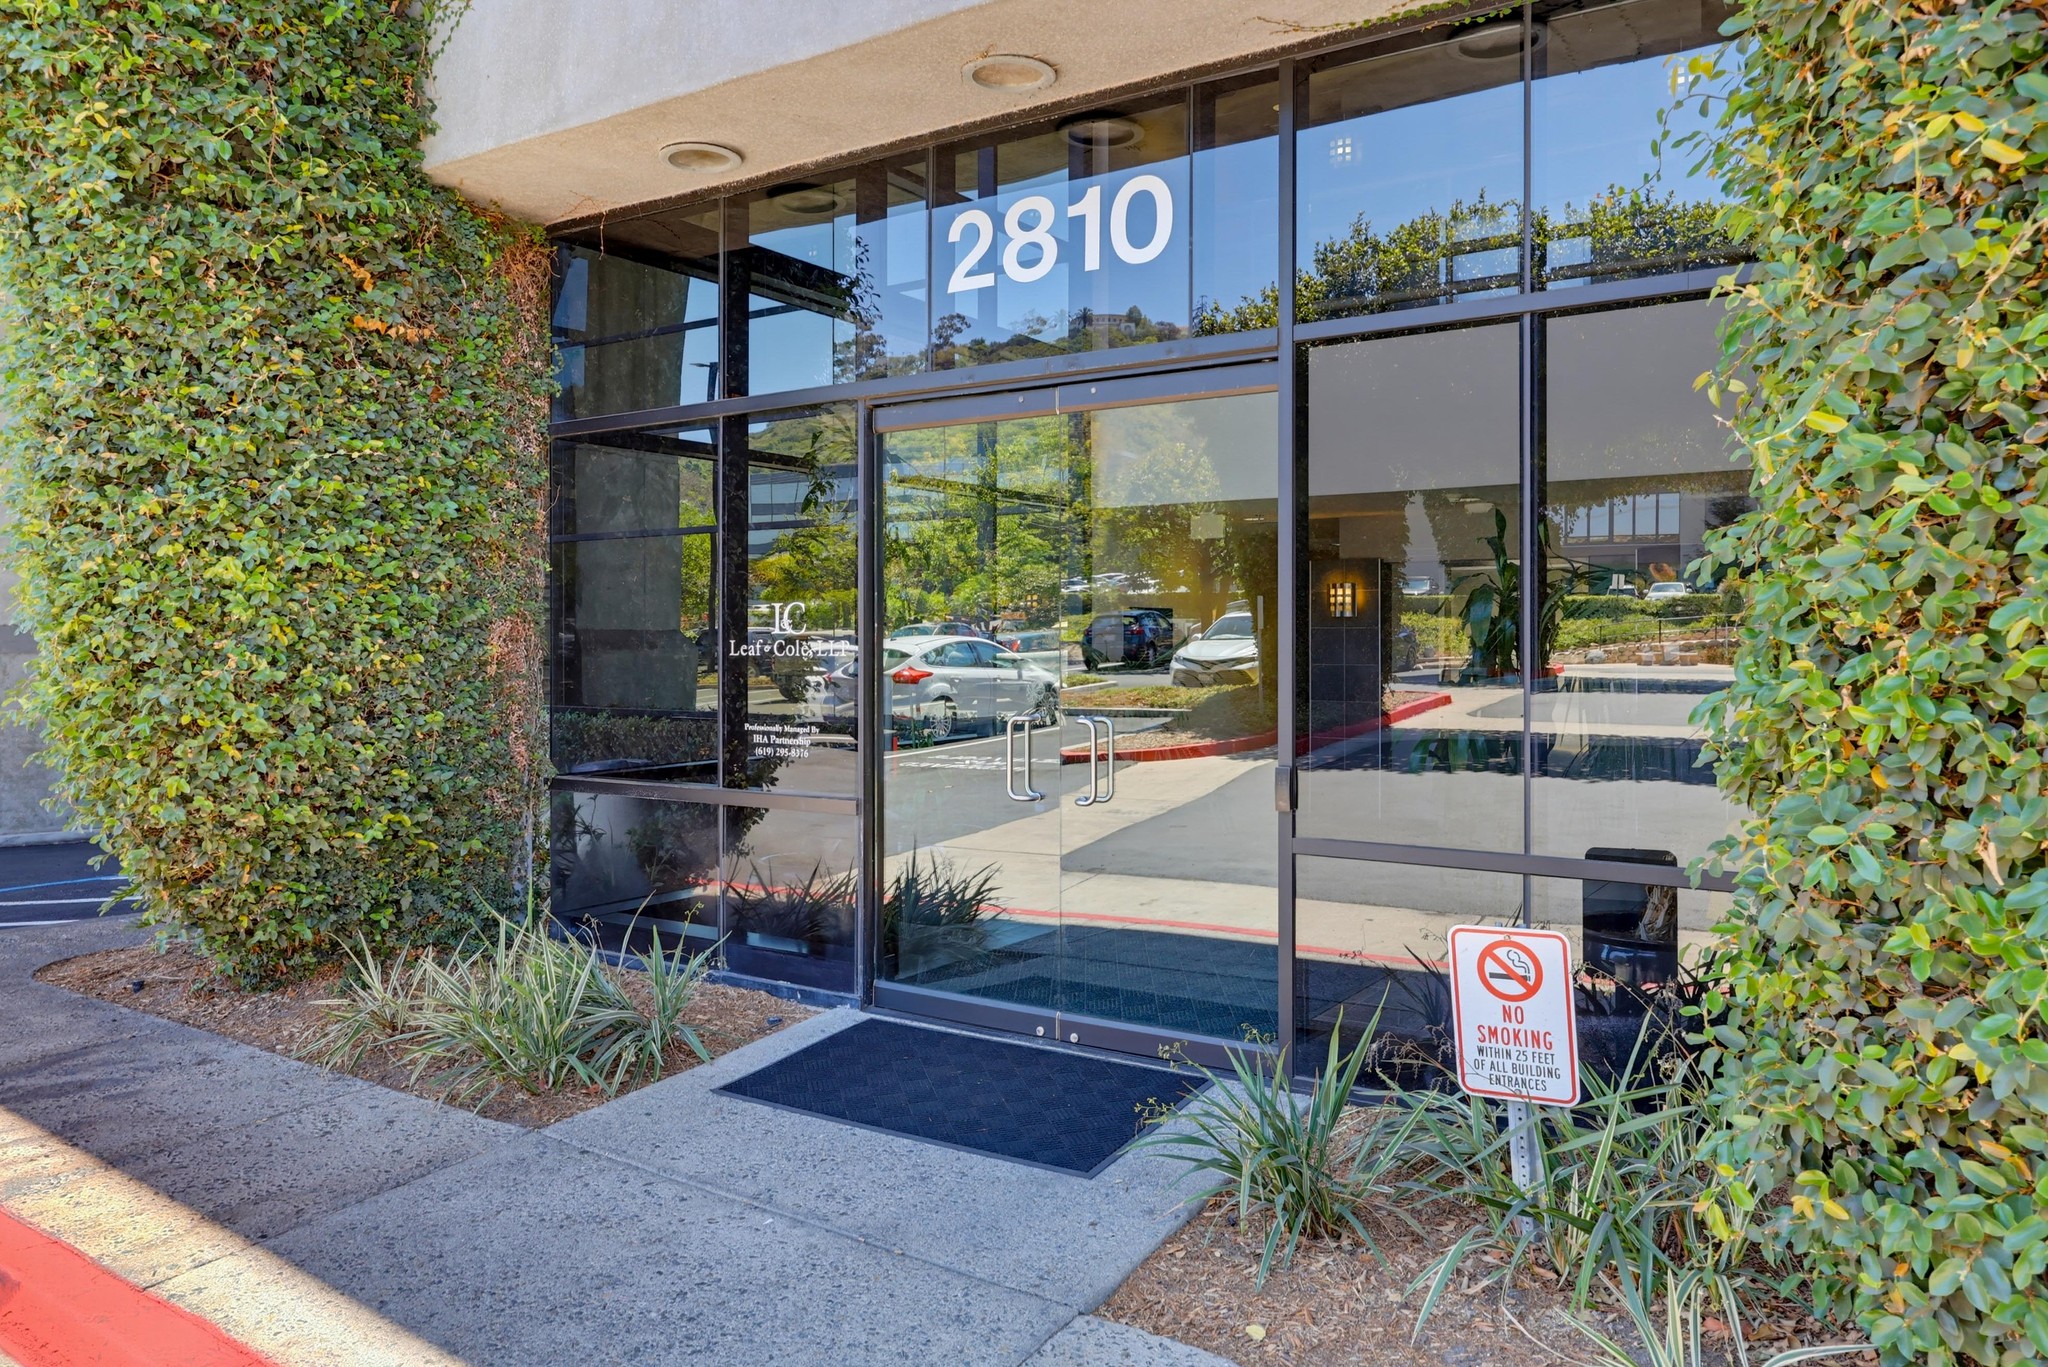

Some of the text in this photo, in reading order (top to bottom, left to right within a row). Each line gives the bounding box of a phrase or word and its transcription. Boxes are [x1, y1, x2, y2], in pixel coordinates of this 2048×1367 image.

[947, 174, 1174, 294] 2810
[729, 639, 763, 656] Leaf
[816, 640, 850, 657] LLP
[744, 723, 820, 734] Professionally Managed By
[753, 734, 811, 747] IHA Partnership
[755, 747, 774, 757] (619)
[1502, 1004, 1524, 1025] NO
[1477, 1024, 1553, 1051] SMOKING
[1477, 1045, 1555, 1065] WITHIN 25 FEET
[1474, 1058, 1561, 1080] OF ALL BUILDING
[1489, 1073, 1547, 1092] ENTRANCES
